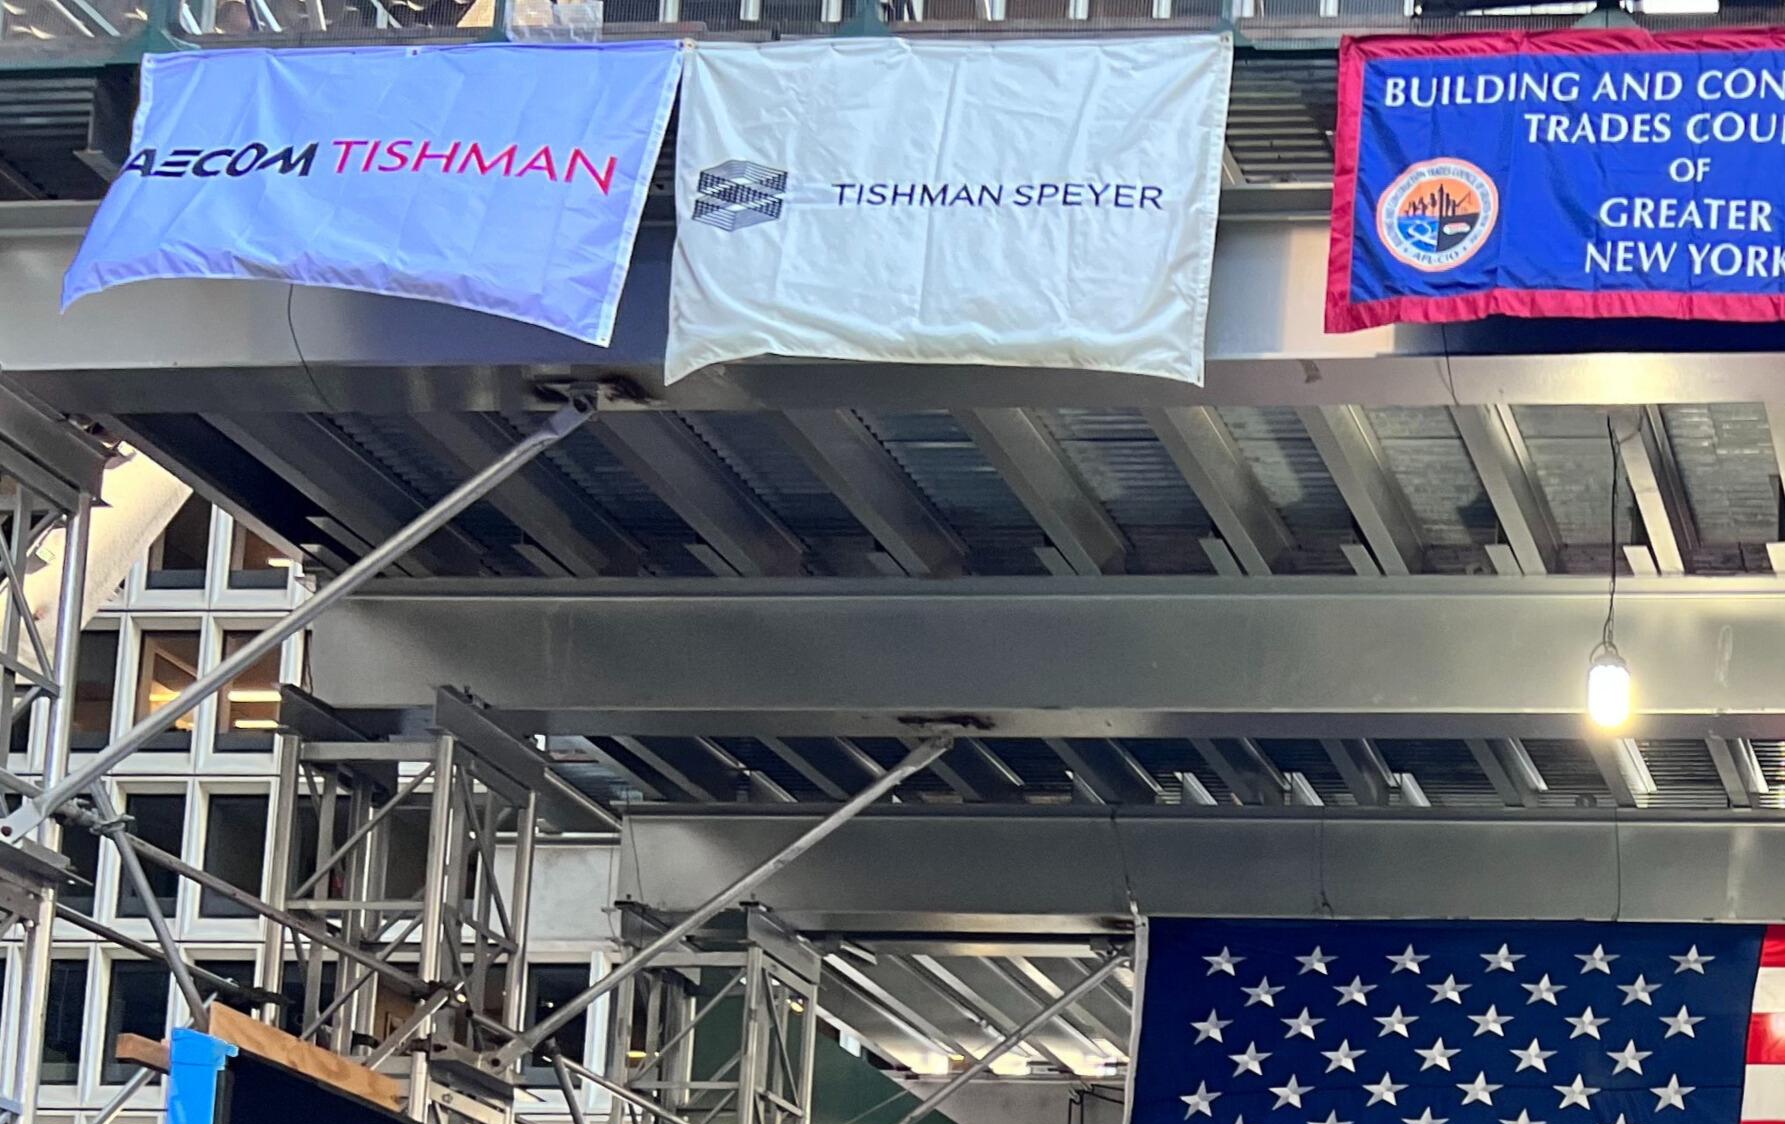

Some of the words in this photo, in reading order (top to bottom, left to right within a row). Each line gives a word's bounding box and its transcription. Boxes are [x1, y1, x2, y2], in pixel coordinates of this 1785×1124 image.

[1384, 70, 1581, 107] BUILDING
[1592, 70, 1683, 102] AND
[1523, 112, 1672, 144] TRADES
[119, 142, 319, 178] AECOM
[334, 140, 618, 196] TISHMAN
[1669, 157, 1711, 184] OF
[833, 183, 1003, 208] TISHMAN
[1013, 183, 1164, 211] SPEYER
[1599, 197, 1773, 233] GREATER
[1584, 240, 1679, 274] NEW
